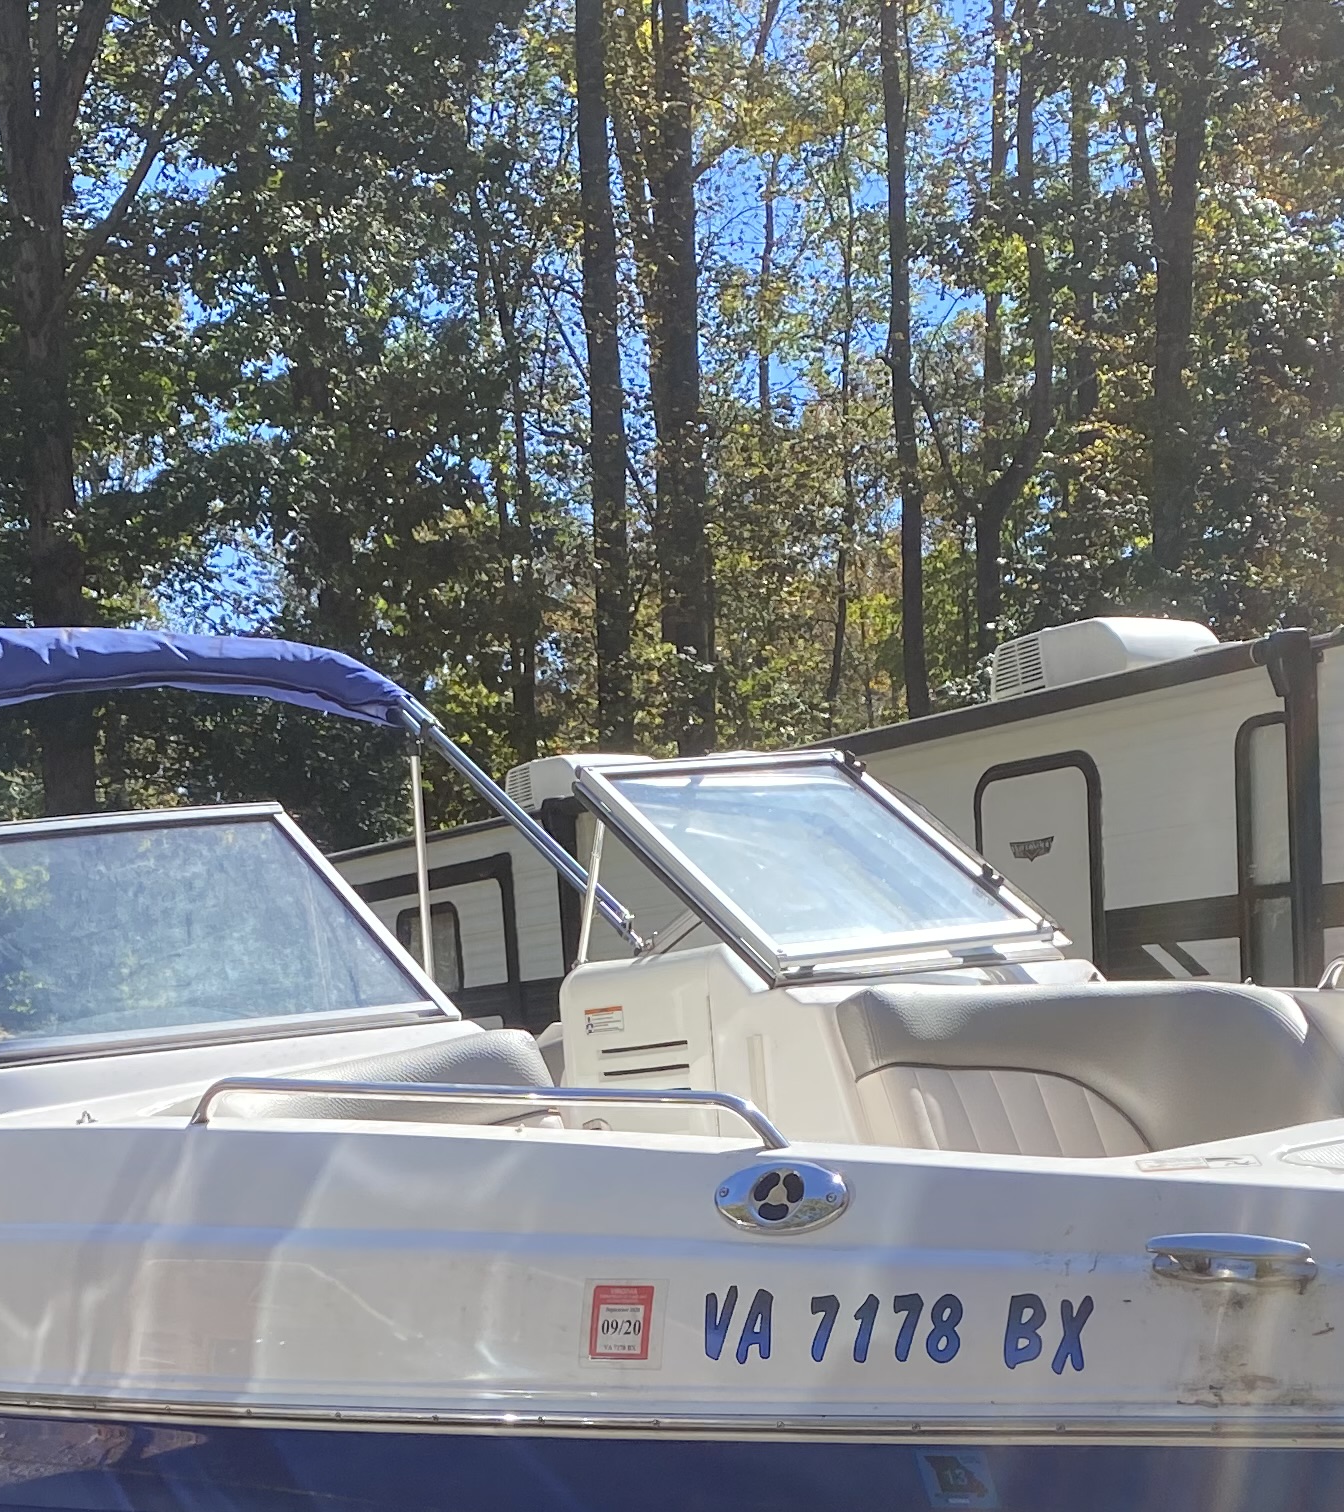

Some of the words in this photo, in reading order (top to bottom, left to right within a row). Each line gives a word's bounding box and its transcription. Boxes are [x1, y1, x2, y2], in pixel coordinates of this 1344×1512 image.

[601, 1319, 642, 1336] 09/20
[704, 1285, 775, 1366] VA
[810, 1293, 964, 1364] 7178
[1003, 1293, 1095, 1376] BX
[945, 1469, 968, 1486] 13
